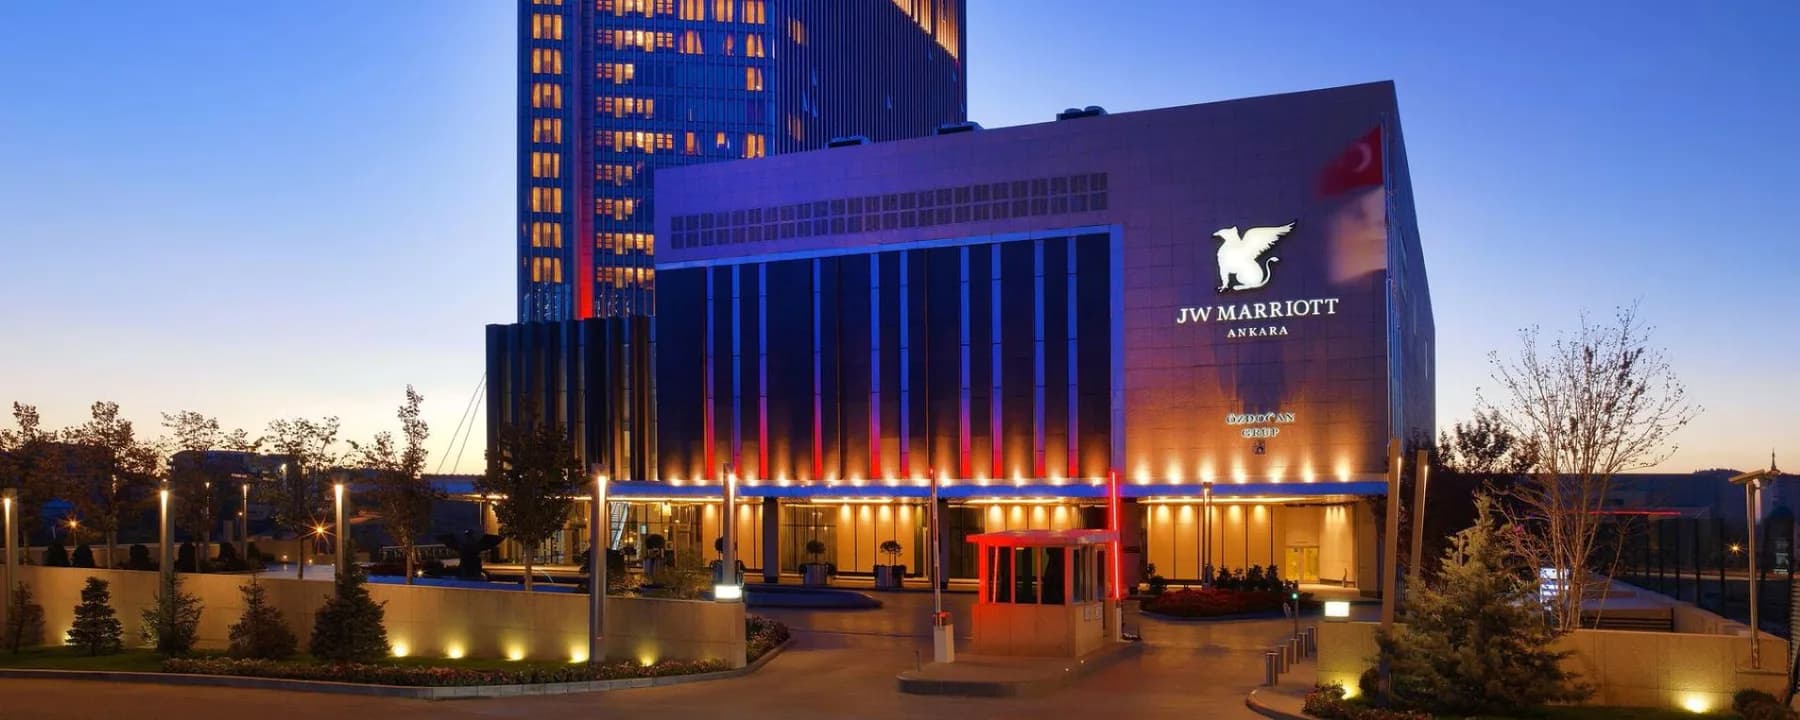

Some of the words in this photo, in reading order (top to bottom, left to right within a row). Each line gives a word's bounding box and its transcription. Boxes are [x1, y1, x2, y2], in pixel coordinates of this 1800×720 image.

[1177, 306, 1212, 324] JW
[1217, 298, 1339, 321] MARRIOTT
[1227, 326, 1288, 338] ANKARA
